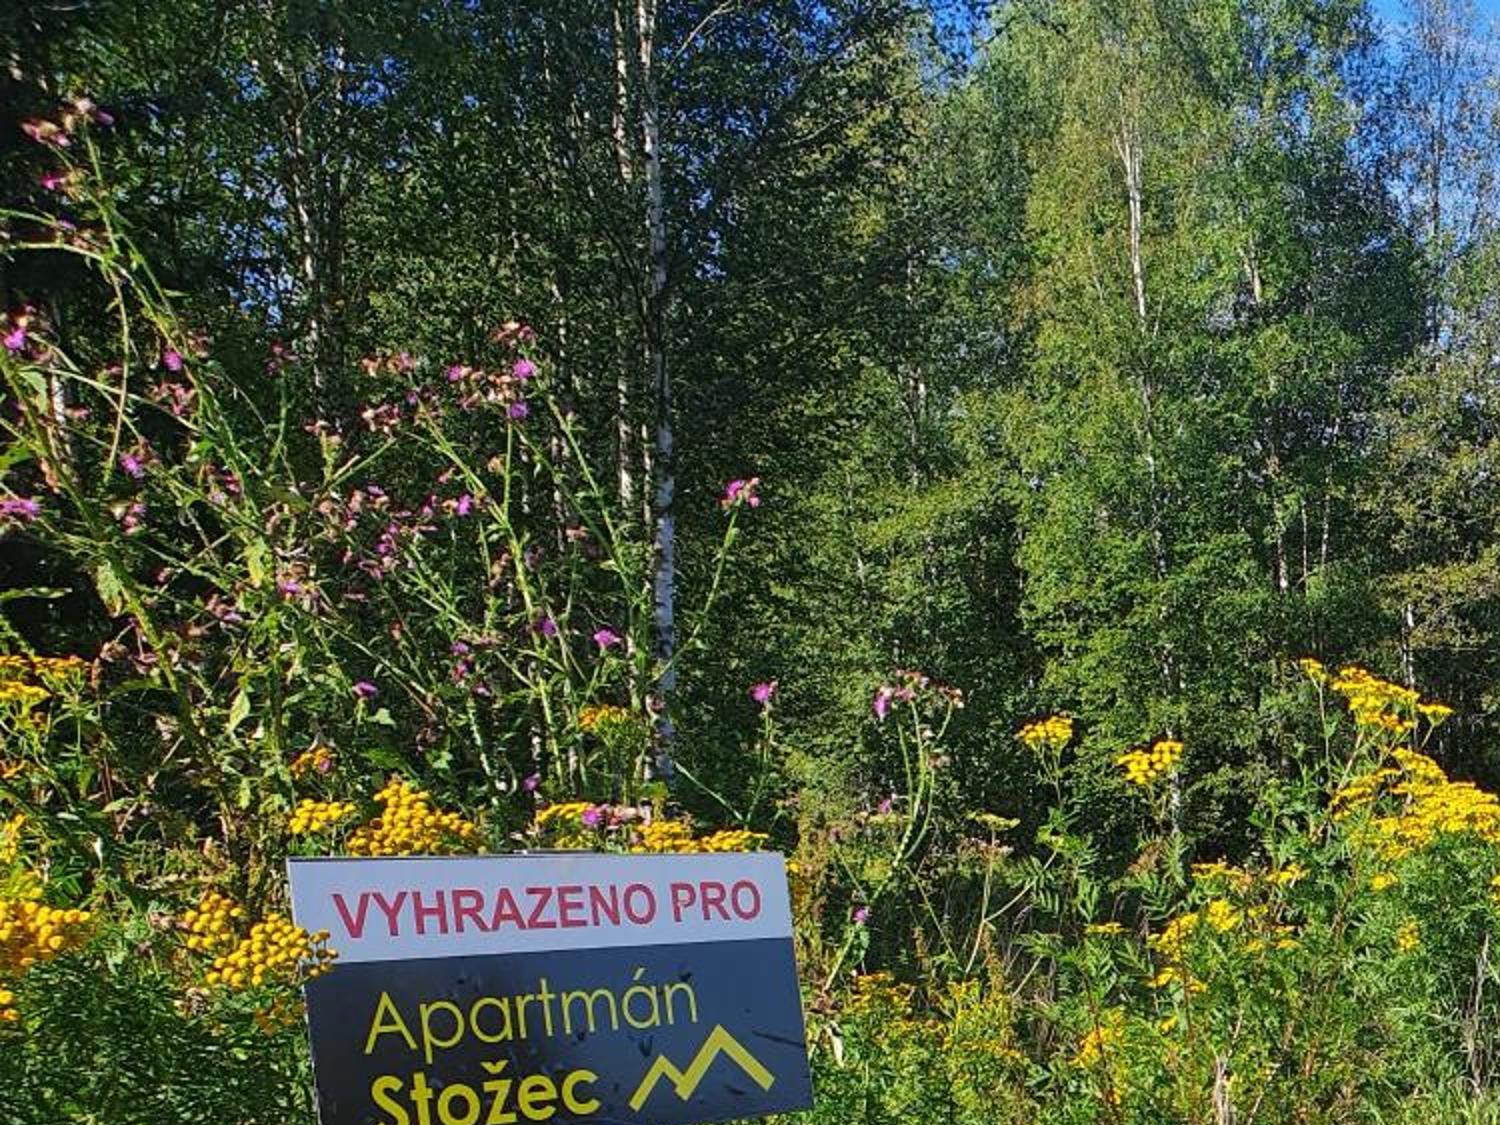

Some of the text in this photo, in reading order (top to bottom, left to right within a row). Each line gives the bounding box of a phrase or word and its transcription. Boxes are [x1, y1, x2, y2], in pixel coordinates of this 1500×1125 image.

[332, 879, 761, 938] VYHRAZENO PRO
[364, 967, 698, 1063] Apartmán
